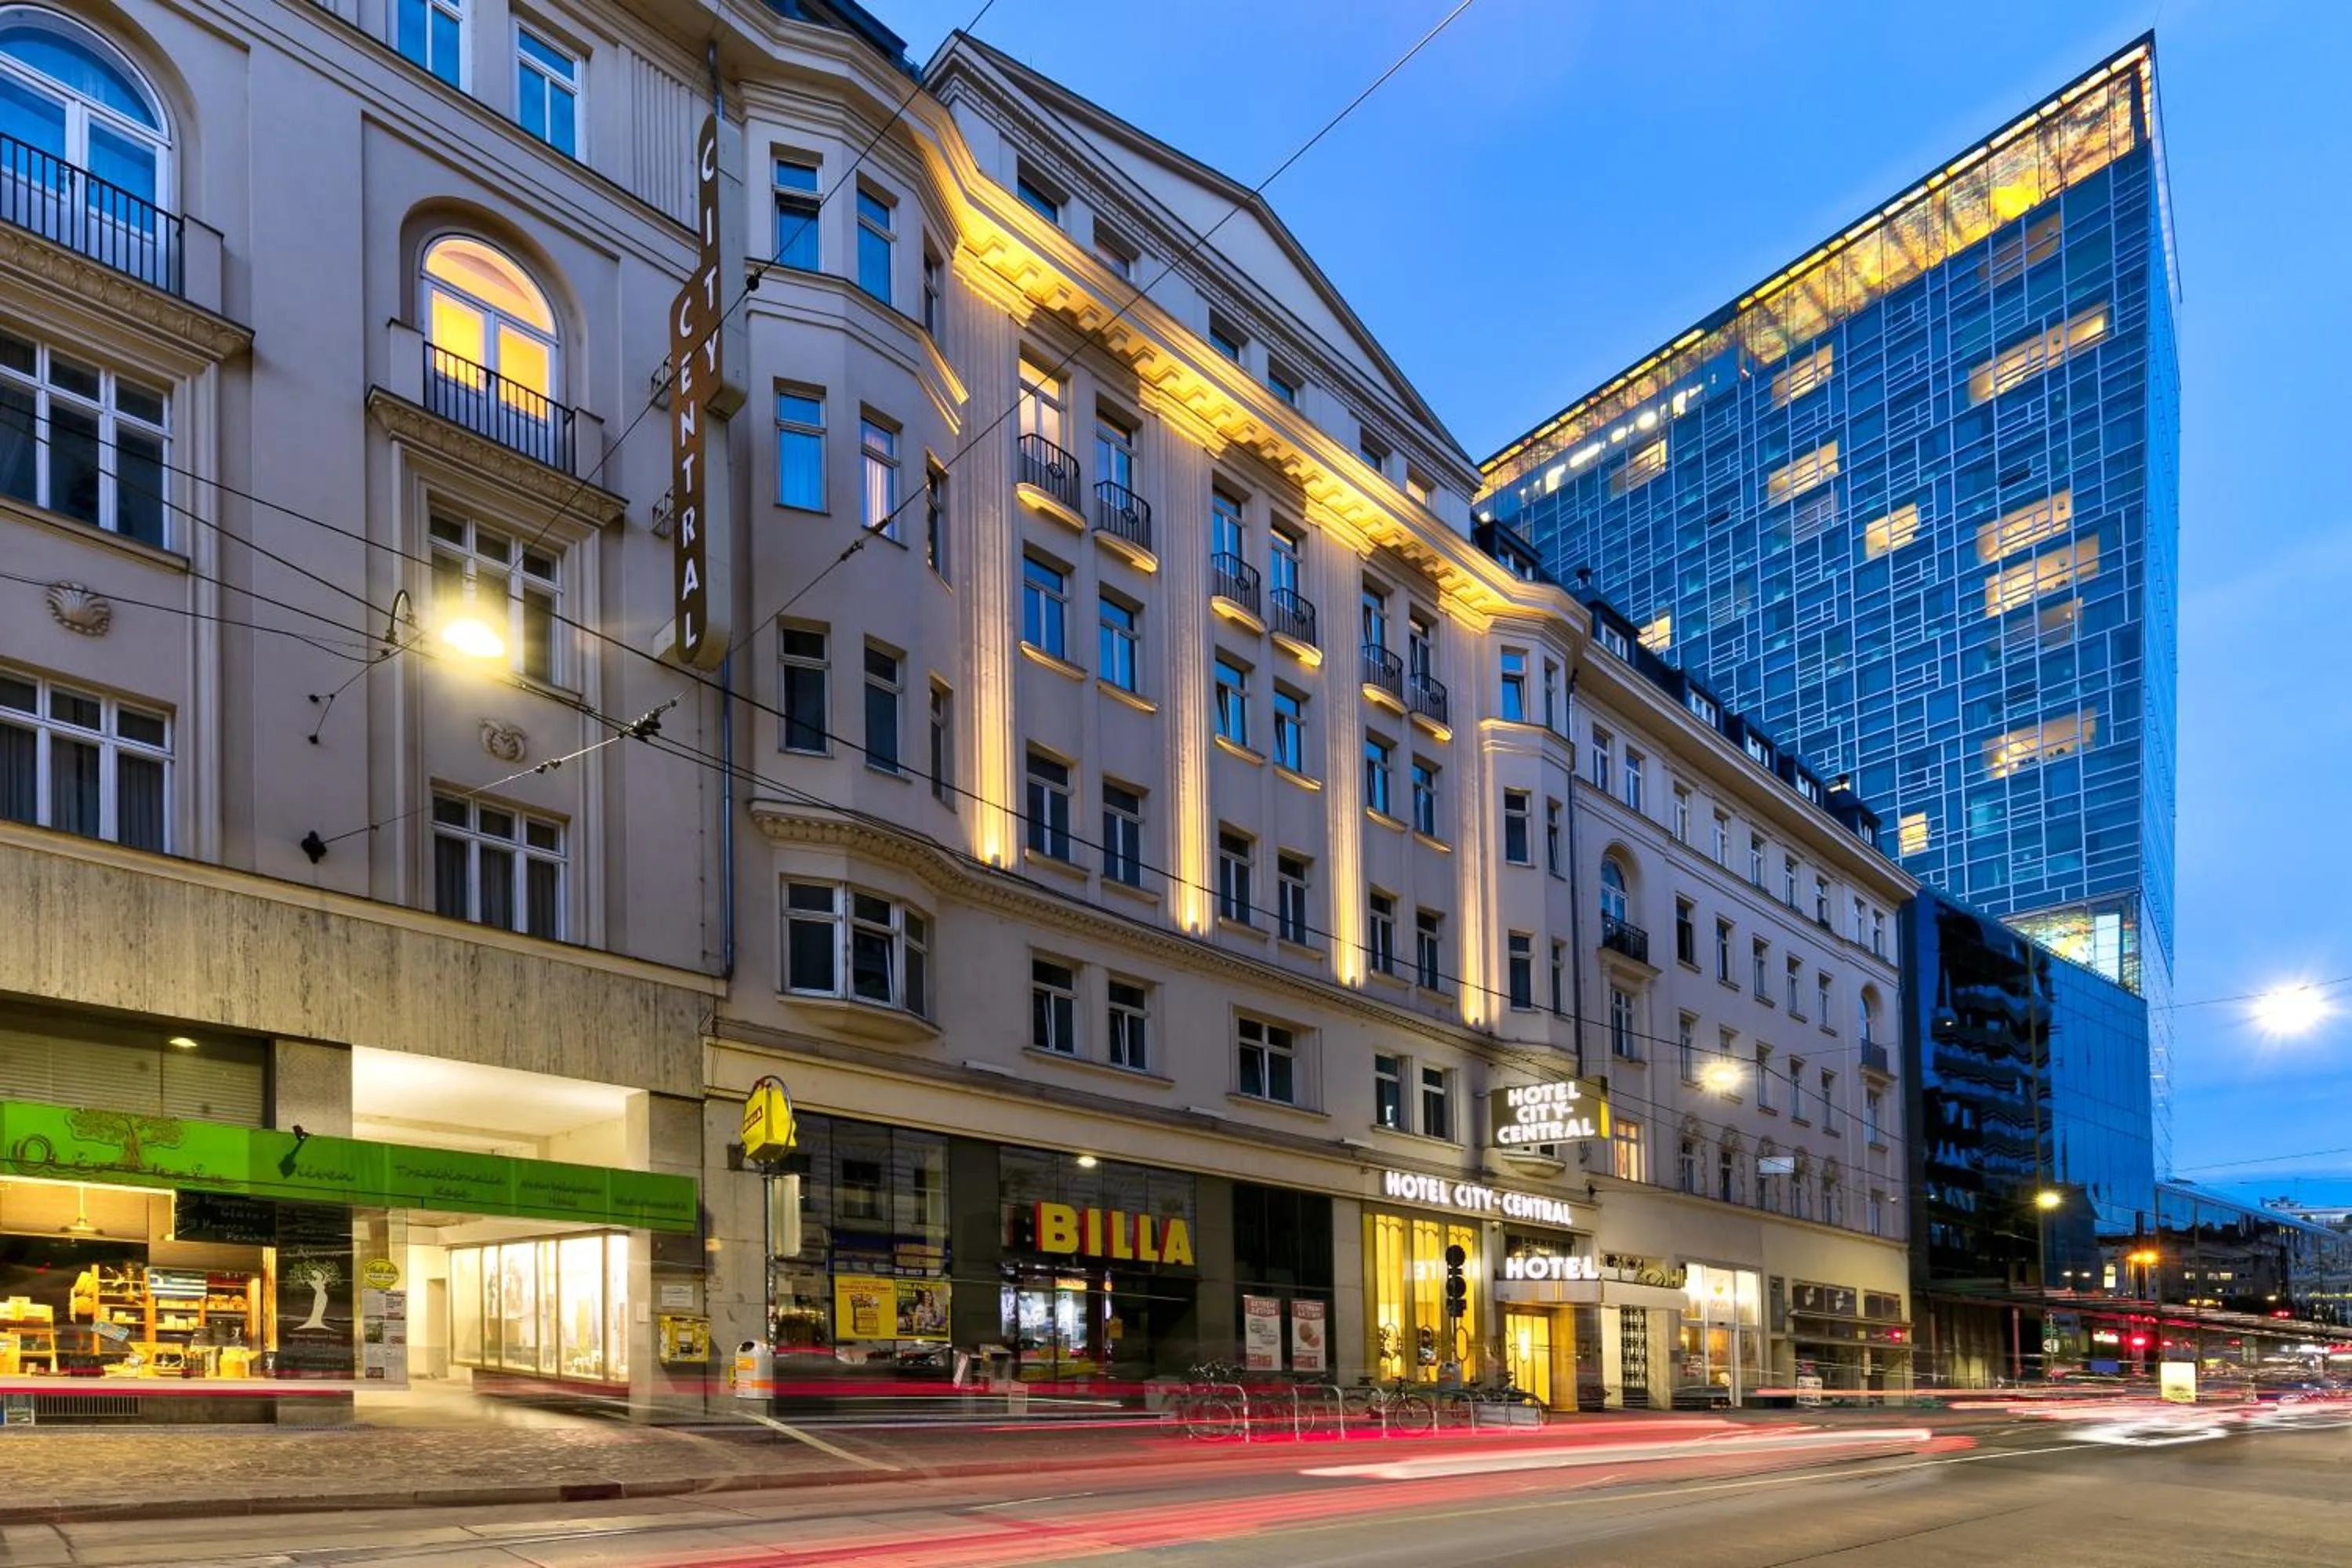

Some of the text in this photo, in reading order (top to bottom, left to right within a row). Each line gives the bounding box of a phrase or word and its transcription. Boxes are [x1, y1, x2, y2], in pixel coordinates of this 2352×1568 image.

[702, 137, 719, 374] CITY
[678, 296, 699, 650] CENTRAL
[1507, 1080, 1581, 1107] HOTEL
[1497, 1116, 1596, 1145] CENTRAL
[1385, 1171, 1450, 1205] HOTEL
[1035, 1200, 1196, 1267] BILLA
[1505, 1256, 1599, 1280] HOTEL
